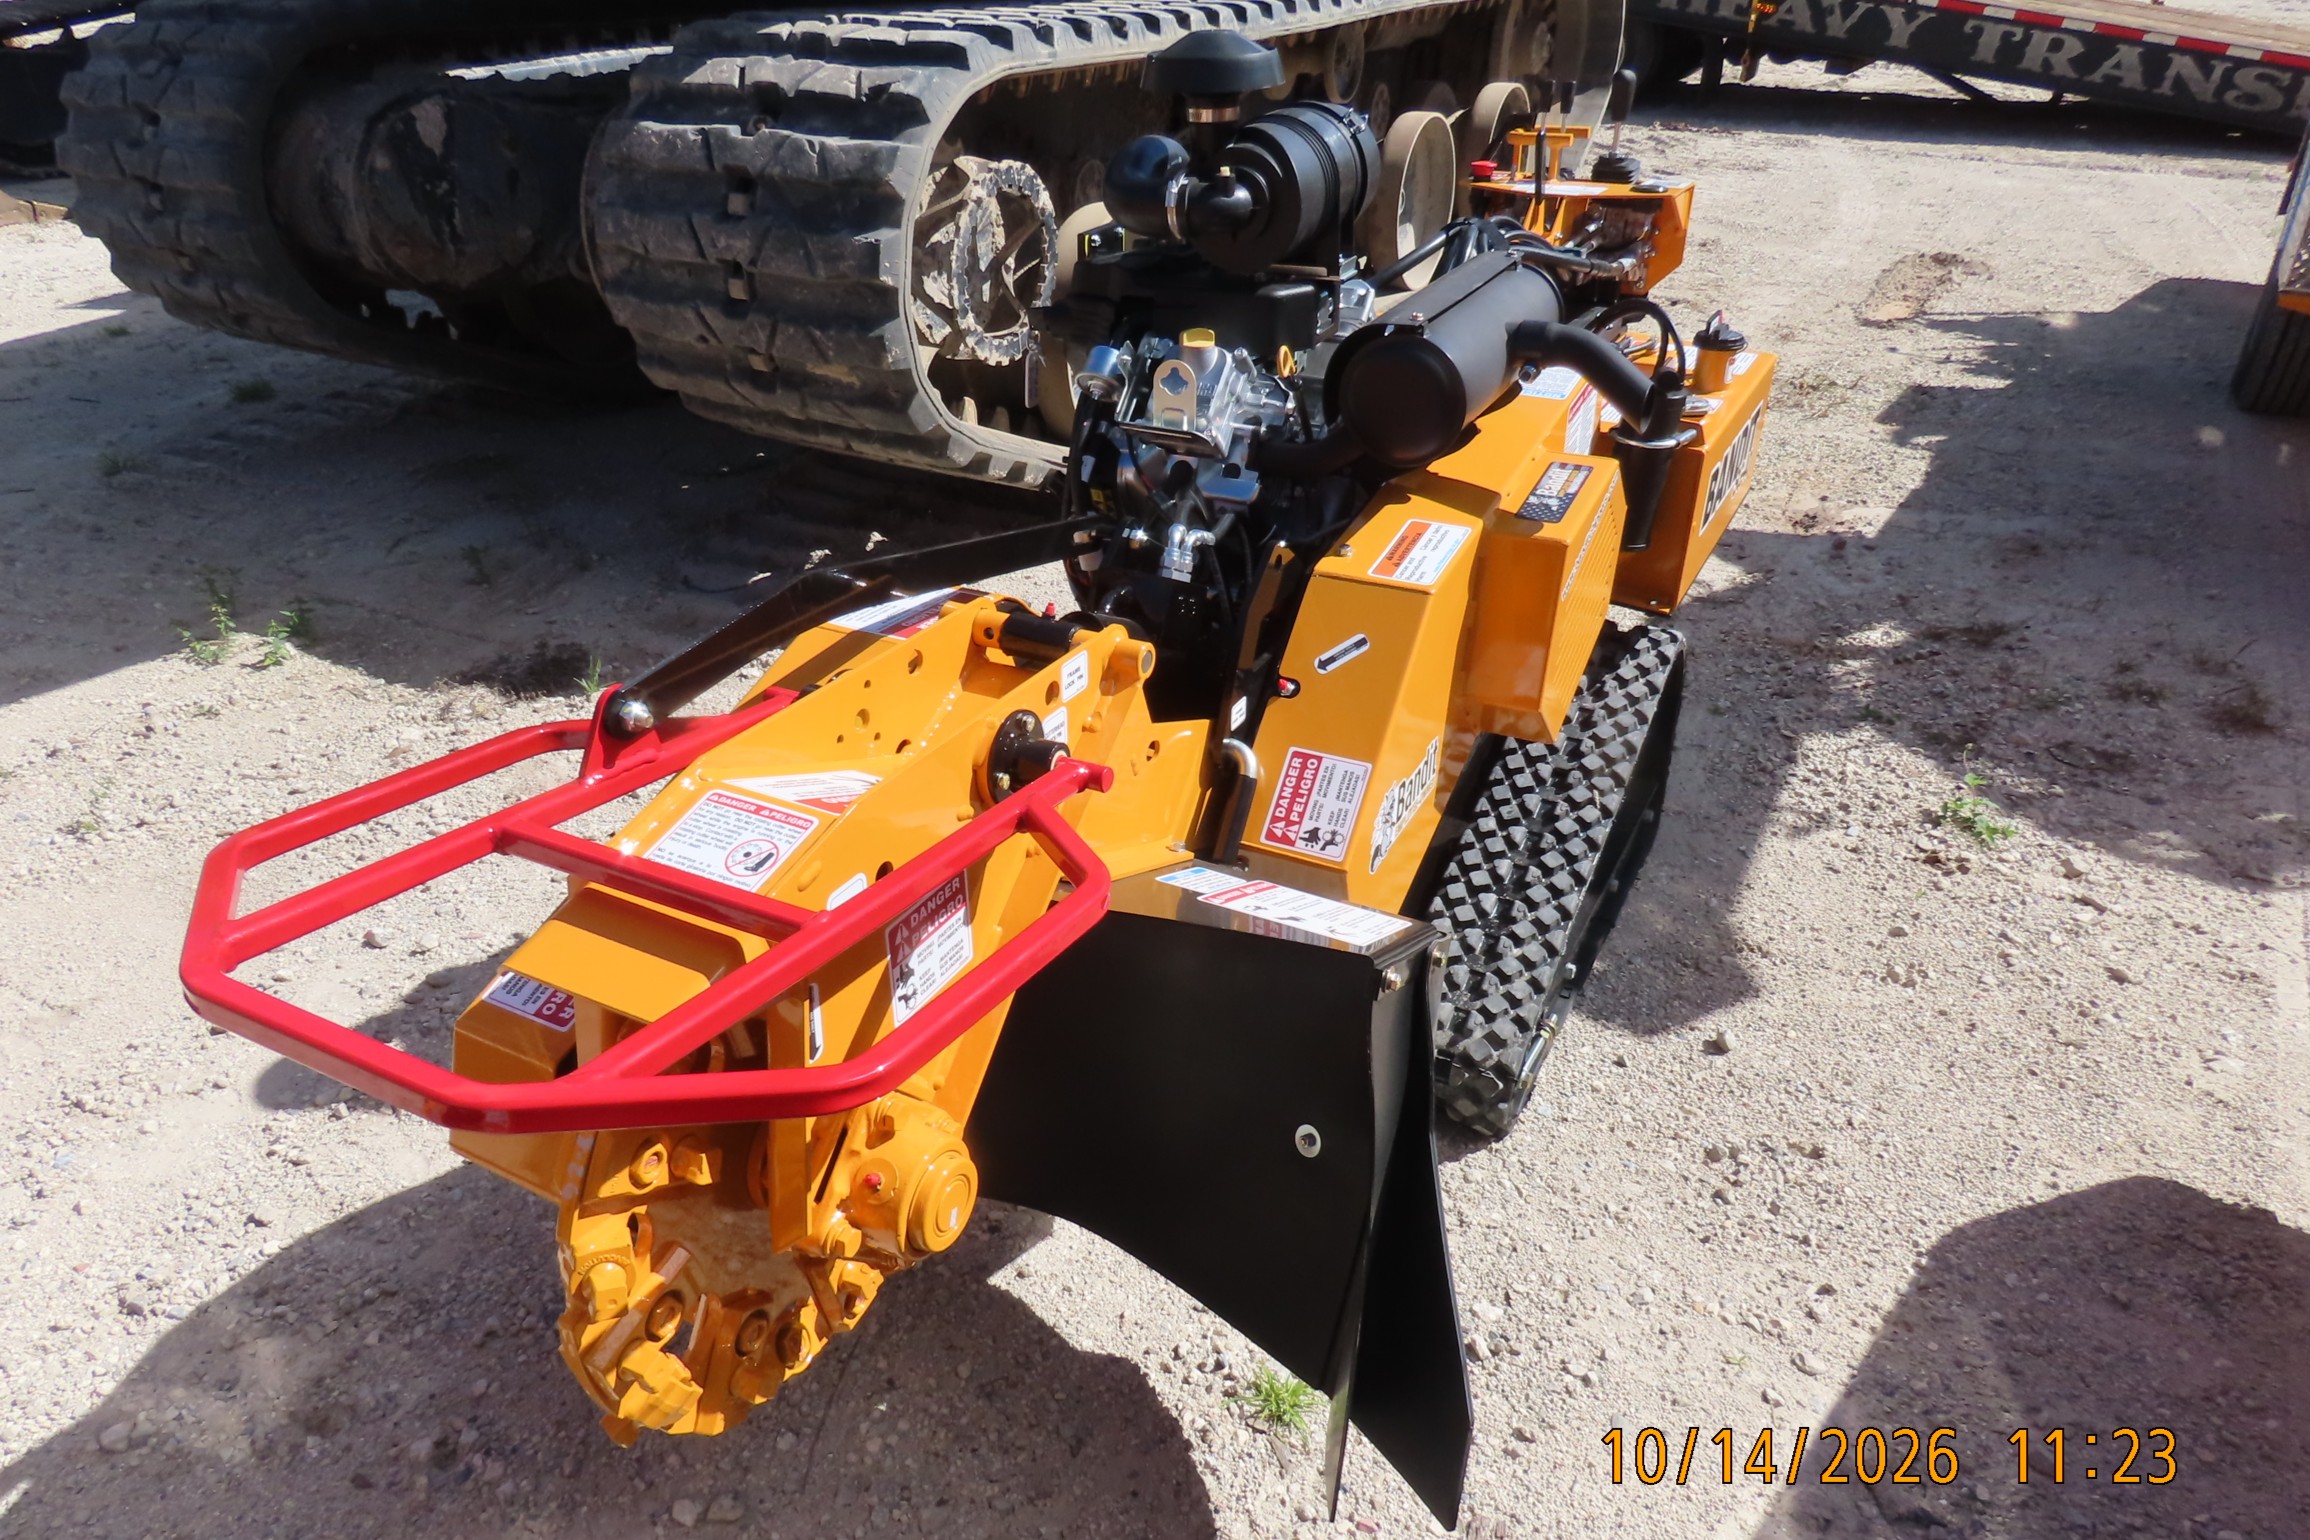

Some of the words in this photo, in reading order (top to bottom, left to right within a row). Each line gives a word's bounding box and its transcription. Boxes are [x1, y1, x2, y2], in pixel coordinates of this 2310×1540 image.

[1536, 468, 1572, 496] Bandit
[1391, 535, 1408, 556] WARNING
[1399, 532, 1422, 561] ADVERTENCIA
[1322, 763, 1336, 798] MOVIMIENTO!
[1323, 765, 1328, 773] EN
[1344, 771, 1354, 790] MANOS
[1396, 742, 1438, 821] Bandit
[1274, 756, 1302, 817] DANGER
[1289, 757, 1318, 822] PELIGRO
[1347, 774, 1360, 804] ALEJADAS!
[717, 796, 758, 811] DANGER
[768, 811, 812, 828] PELIGRO
[1308, 799, 1318, 820] MOVING
[1314, 802, 1323, 822] PARTS!
[1327, 810, 1335, 825] KEEP
[1333, 807, 1342, 826] HANDS
[1339, 808, 1349, 828] CLEAR!
[912, 877, 960, 925] DANGER
[912, 894, 963, 946] PELIGRO
